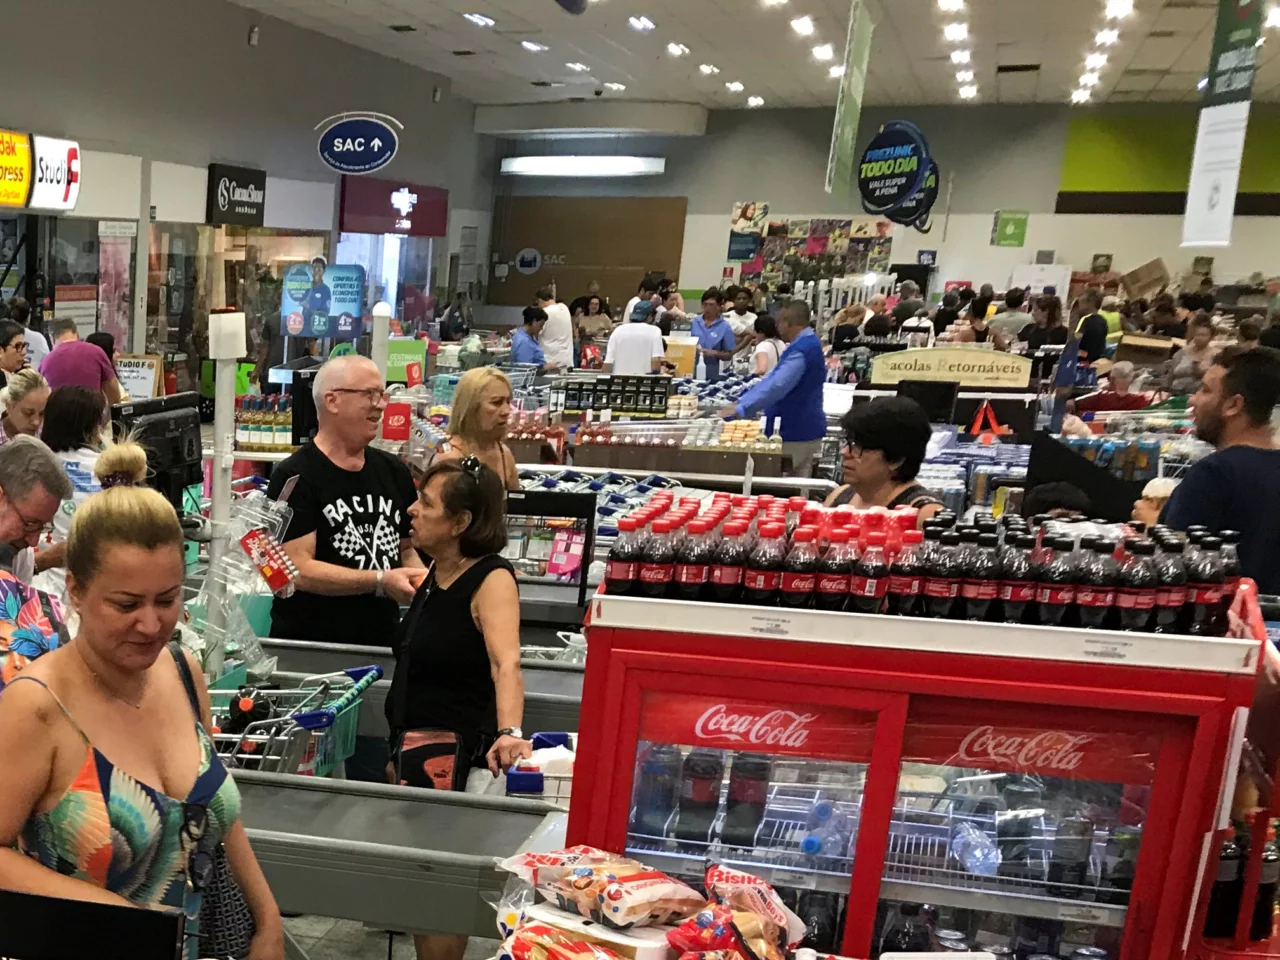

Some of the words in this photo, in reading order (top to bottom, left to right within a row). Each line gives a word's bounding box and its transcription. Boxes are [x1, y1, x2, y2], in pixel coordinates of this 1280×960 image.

[333, 138, 365, 152] SAC
[861, 159, 895, 178] TODO
[895, 156, 918, 175] DIA
[884, 177, 907, 188] SUPER
[543, 254, 566, 265] SAC
[882, 358, 931, 372] Sacolas
[936, 358, 1022, 374] Retornáveis
[323, 495, 401, 528] RACING
[694, 704, 820, 748] Coca-Cola
[958, 724, 1094, 771] Coca-Cola
